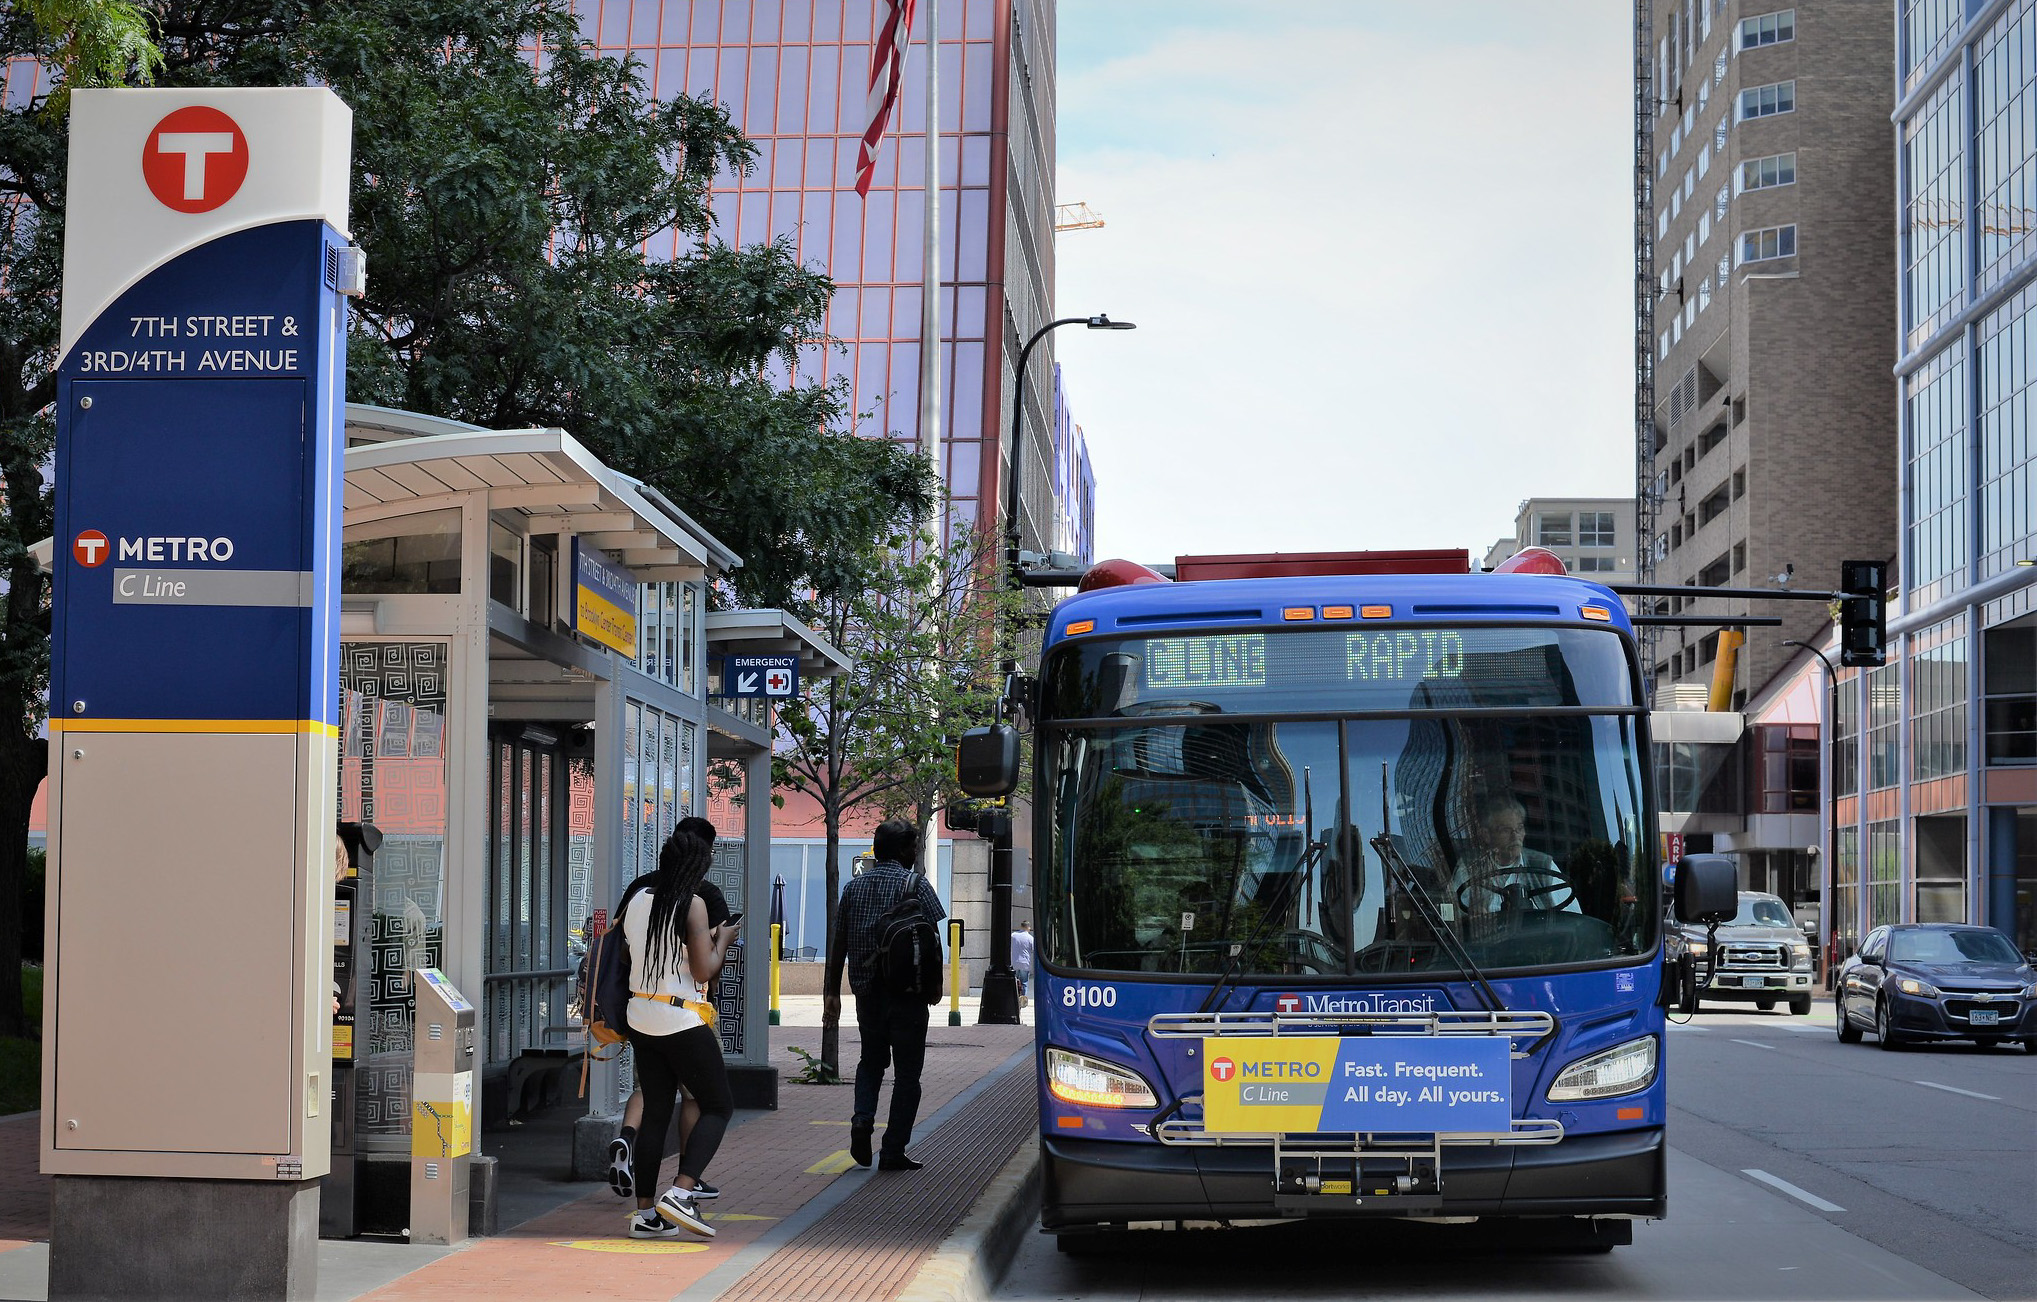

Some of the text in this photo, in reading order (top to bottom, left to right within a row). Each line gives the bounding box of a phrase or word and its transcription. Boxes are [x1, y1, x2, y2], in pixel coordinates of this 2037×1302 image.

[158, 132, 234, 200] T
[130, 315, 299, 338] 7TH STREET &
[80, 350, 298, 372] 3RD/4TH AVENUE
[78, 536, 234, 564] T METRO
[119, 574, 186, 597] C Line
[735, 658, 795, 667] EMERGENCY
[1184, 637, 1263, 681] LINE
[1346, 631, 1463, 679] RAPID
[1672, 833, 1680, 863] ARK
[1063, 985, 1117, 1008] 8100
[1213, 1061, 1321, 1079] T METRO
[1344, 1061, 1484, 1082] Fast. Frequent.
[1243, 1086, 1289, 1102] C Line
[1344, 1085, 1505, 1107] All day. All yours.
